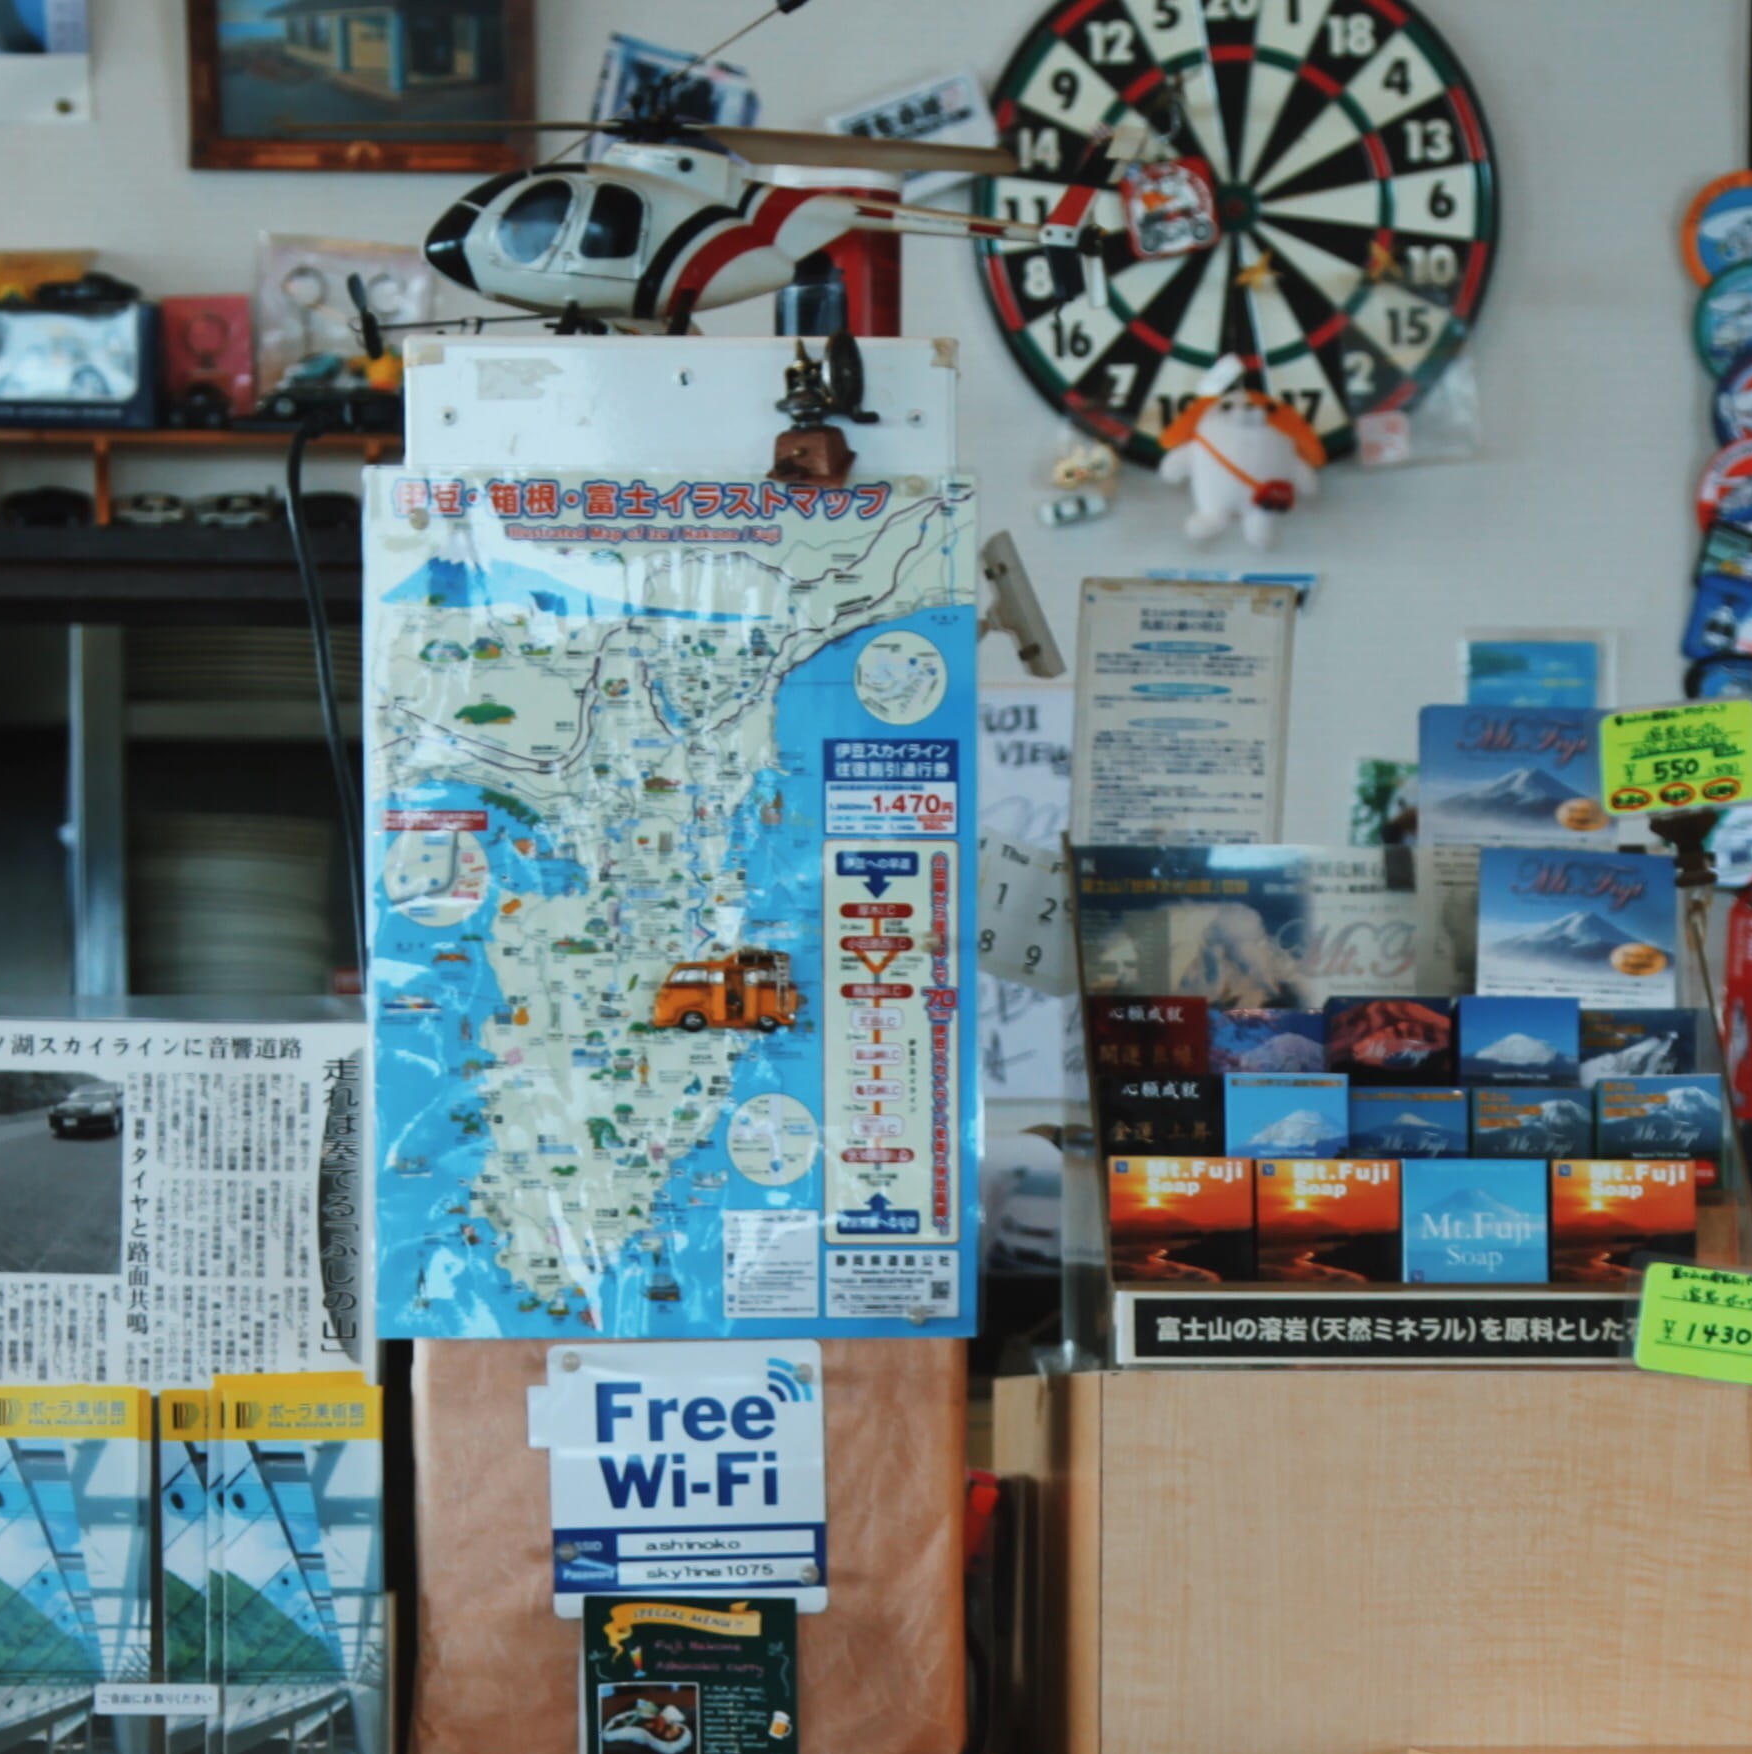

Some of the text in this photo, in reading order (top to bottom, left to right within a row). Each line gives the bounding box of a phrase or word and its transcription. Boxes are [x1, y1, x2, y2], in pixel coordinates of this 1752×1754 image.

[1087, 20, 1133, 63] 12
[1327, 13, 1375, 56] 18
[1052, 69, 1079, 110] 9
[1382, 59, 1412, 98] 4
[1018, 128, 1060, 169] 14
[1405, 119, 1452, 160] 13
[1428, 183, 1455, 219] 6
[1024, 256, 1051, 298] 8
[1408, 243, 1456, 285] 10
[1051, 320, 1092, 359] 16
[1386, 307, 1430, 346] 15
[1106, 363, 1137, 407] 7
[1344, 351, 1375, 394] 2
[392, 478, 890, 520] 伊豆・箱根・富士イラストマップ
[506, 524, 586, 541] Illustrated
[1653, 758, 1699, 781] 550
[1000, 843, 1031, 866] Thu
[997, 882, 1057, 923] 1 2
[1024, 946, 1041, 970] 9
[1147, 1161, 1243, 1183] Mt.Fuji
[1148, 1178, 1200, 1196] Soap
[1294, 1163, 1390, 1184] Mt.Fuji
[1295, 1180, 1347, 1198] Soap
[1590, 1163, 1687, 1185] Mt.Fuji
[1591, 1181, 1644, 1199] Soap
[320, 1057, 360, 1354] 走れば奏でる「ふじの山」
[126, 1149, 149, 1336] タイヤと路面共鳴
[1421, 1212, 1532, 1246] Mt.Fuji
[1446, 1245, 1504, 1272] Soap
[1686, 1322, 1752, 1345] 1430
[29, 1401, 126, 1417] ポーラ美術館
[268, 1402, 365, 1418] ポーラ美術館
[595, 1382, 777, 1443] Free
[598, 1452, 779, 1509] Wi-Fi
[646, 1537, 741, 1551] ashinoko
[101, 1691, 213, 1706] ご自由にお取りください
